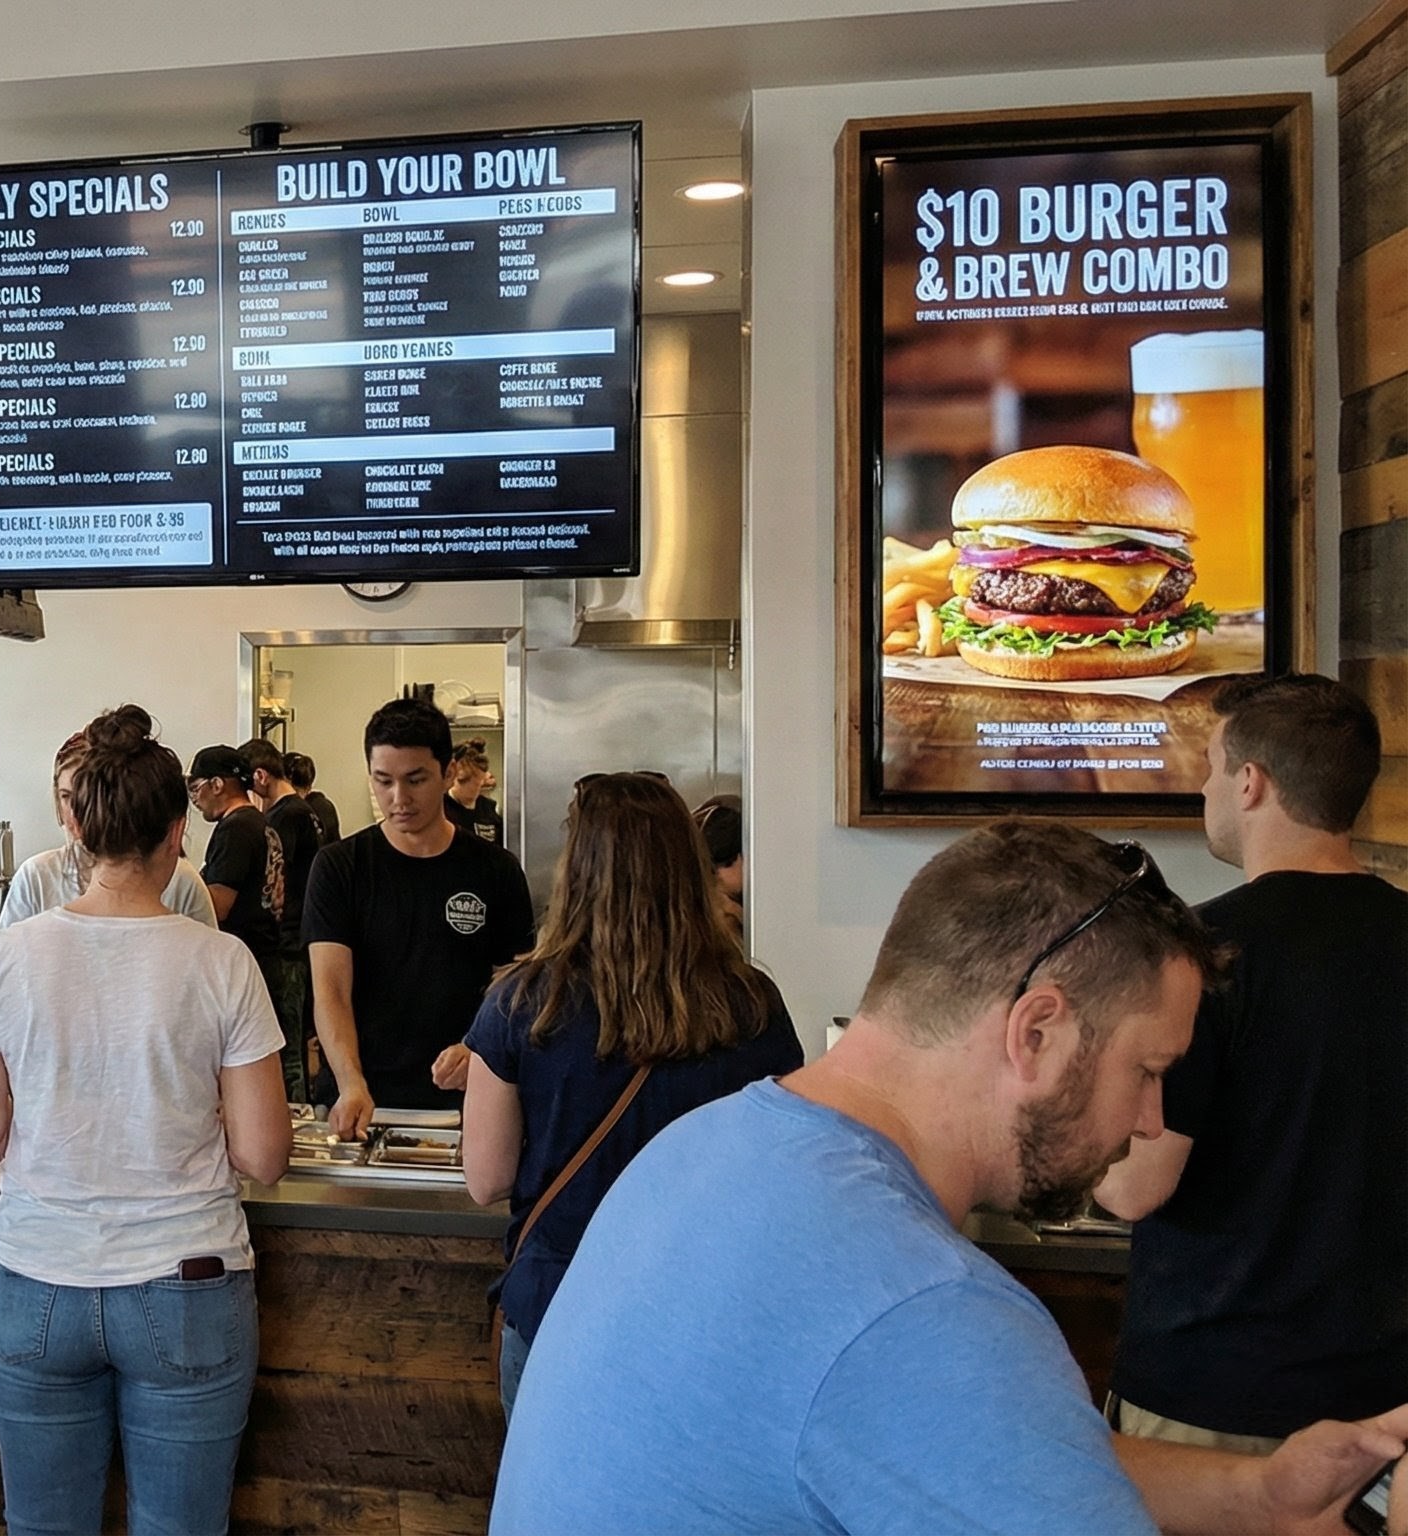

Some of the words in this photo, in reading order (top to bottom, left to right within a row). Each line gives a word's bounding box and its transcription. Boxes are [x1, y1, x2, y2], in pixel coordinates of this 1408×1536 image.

[29, 173, 169, 218] SPECIALS
[277, 159, 367, 202] BUILD
[378, 153, 462, 196] YOUR
[474, 147, 566, 190] BOWL
[363, 207, 400, 223] BOWL
[915, 188, 1000, 252] $10
[1019, 177, 1228, 244] BURGER
[915, 256, 948, 301] &
[954, 251, 1070, 300] BREW
[1083, 244, 1229, 295] COMBO
